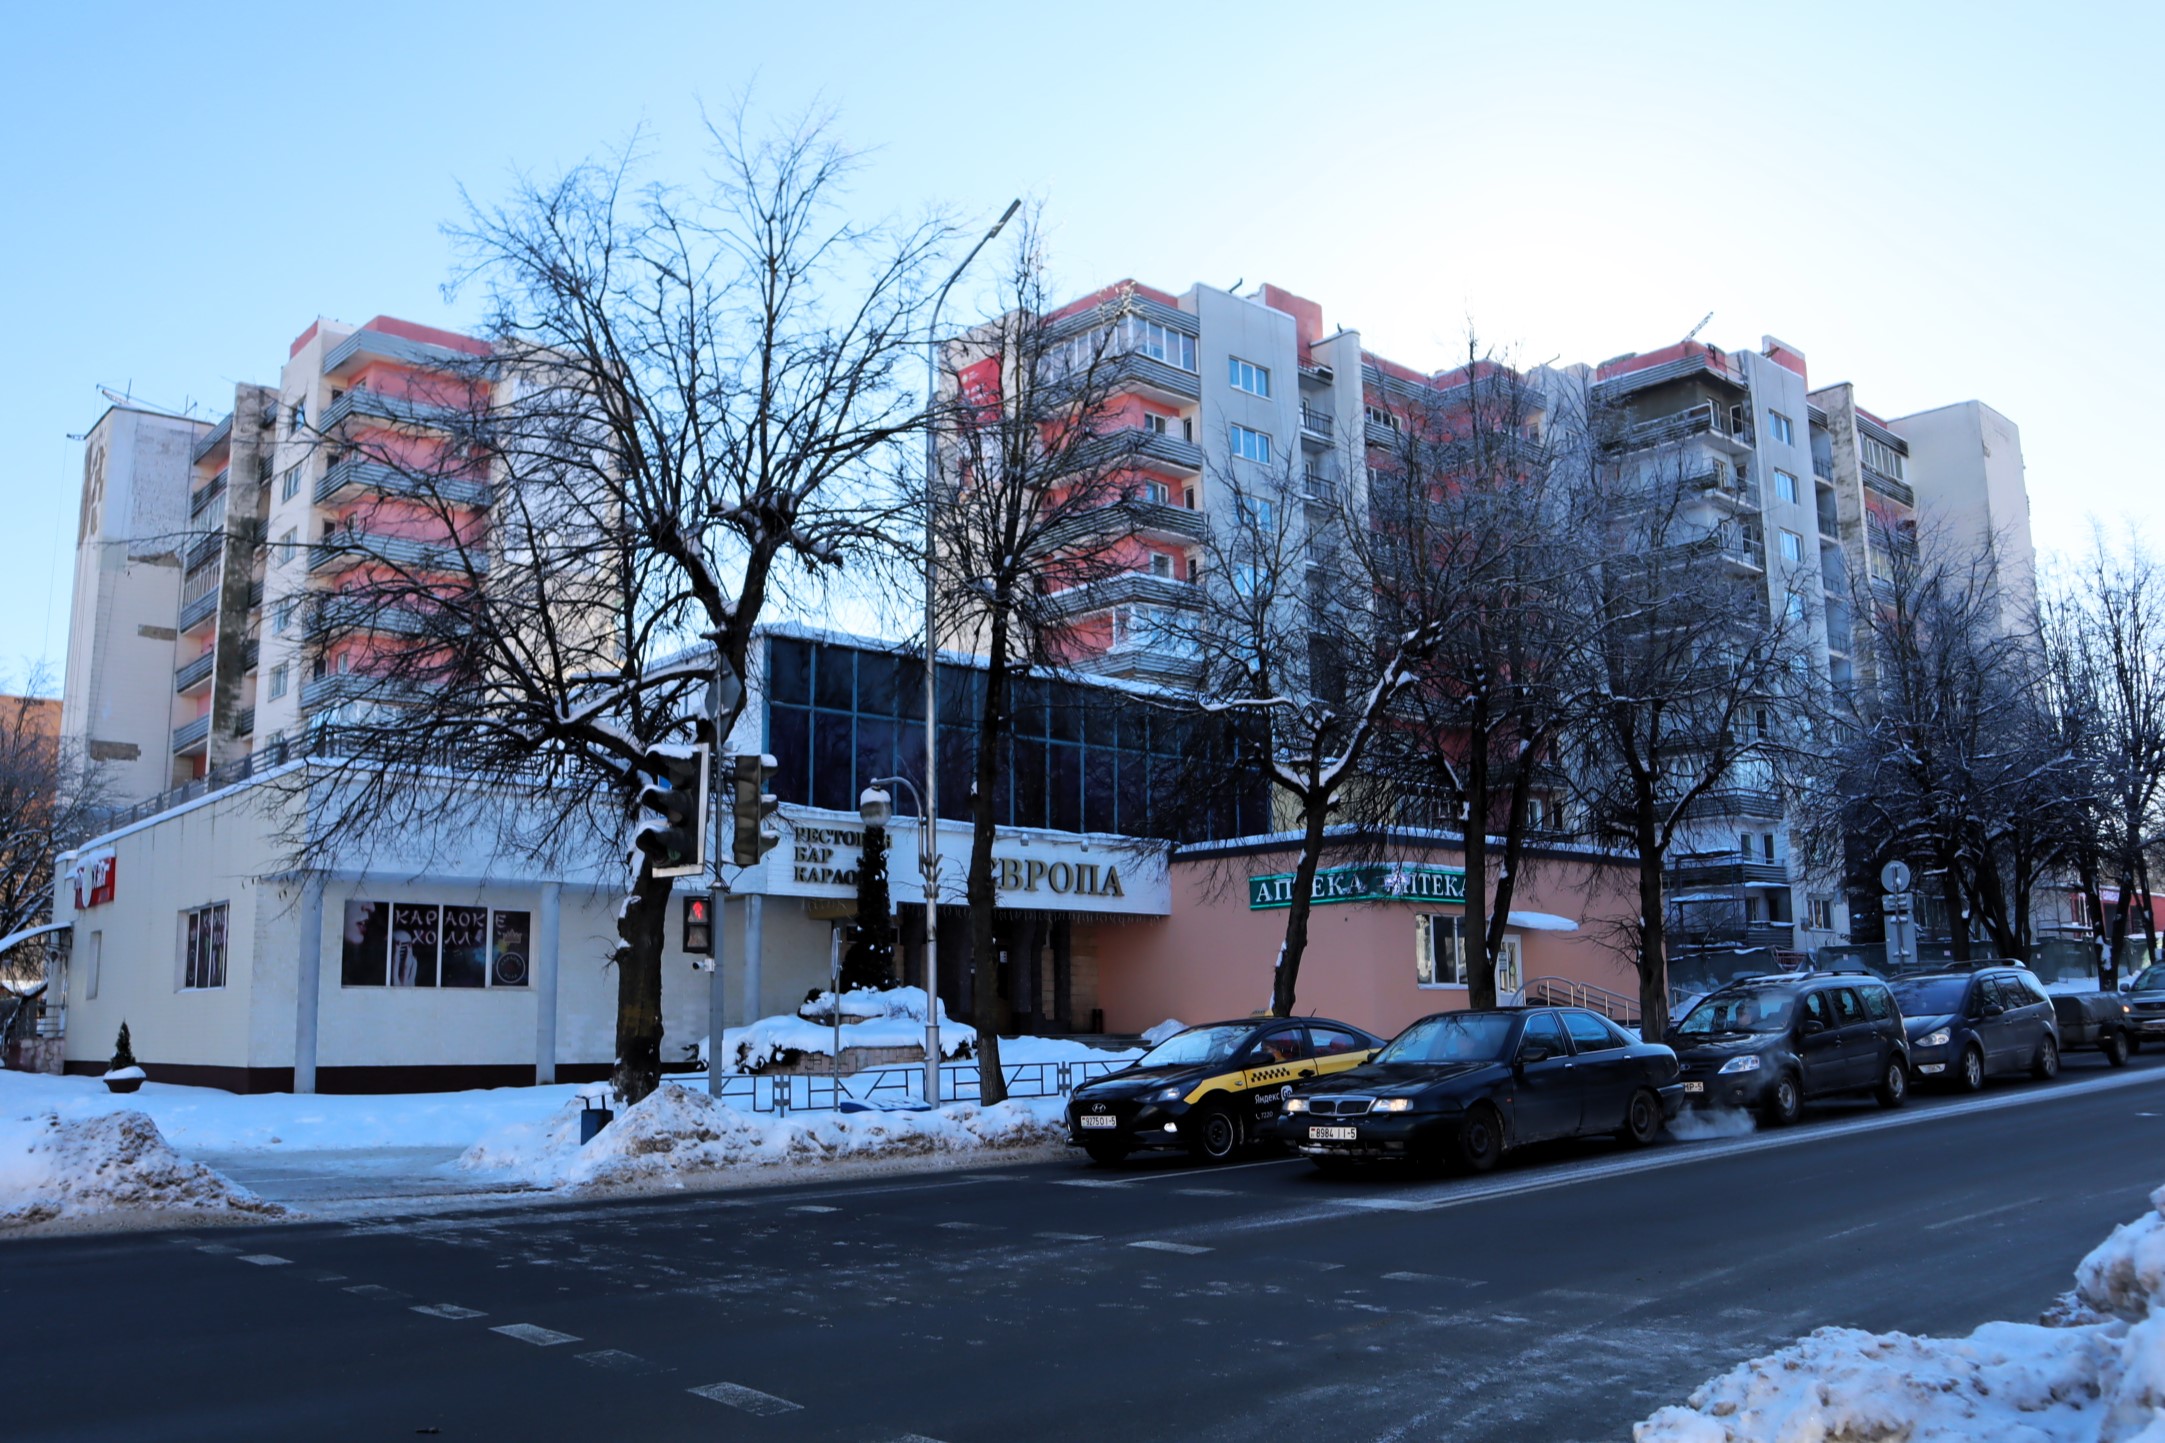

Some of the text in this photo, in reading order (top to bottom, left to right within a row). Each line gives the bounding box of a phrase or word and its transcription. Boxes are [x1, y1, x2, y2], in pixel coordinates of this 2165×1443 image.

[794, 827, 892, 849] РЕСТОН
[794, 846, 833, 863] БАР
[794, 866, 858, 886] КАРАО
[991, 857, 1125, 897] ВРОПА
[1256, 873, 1367, 902] АПЕКА
[395, 909, 507, 928] КАРАОКЕ
[412, 930, 472, 946] ХОЛЛ
[1255, 1092, 1280, 1105] Яндекс
